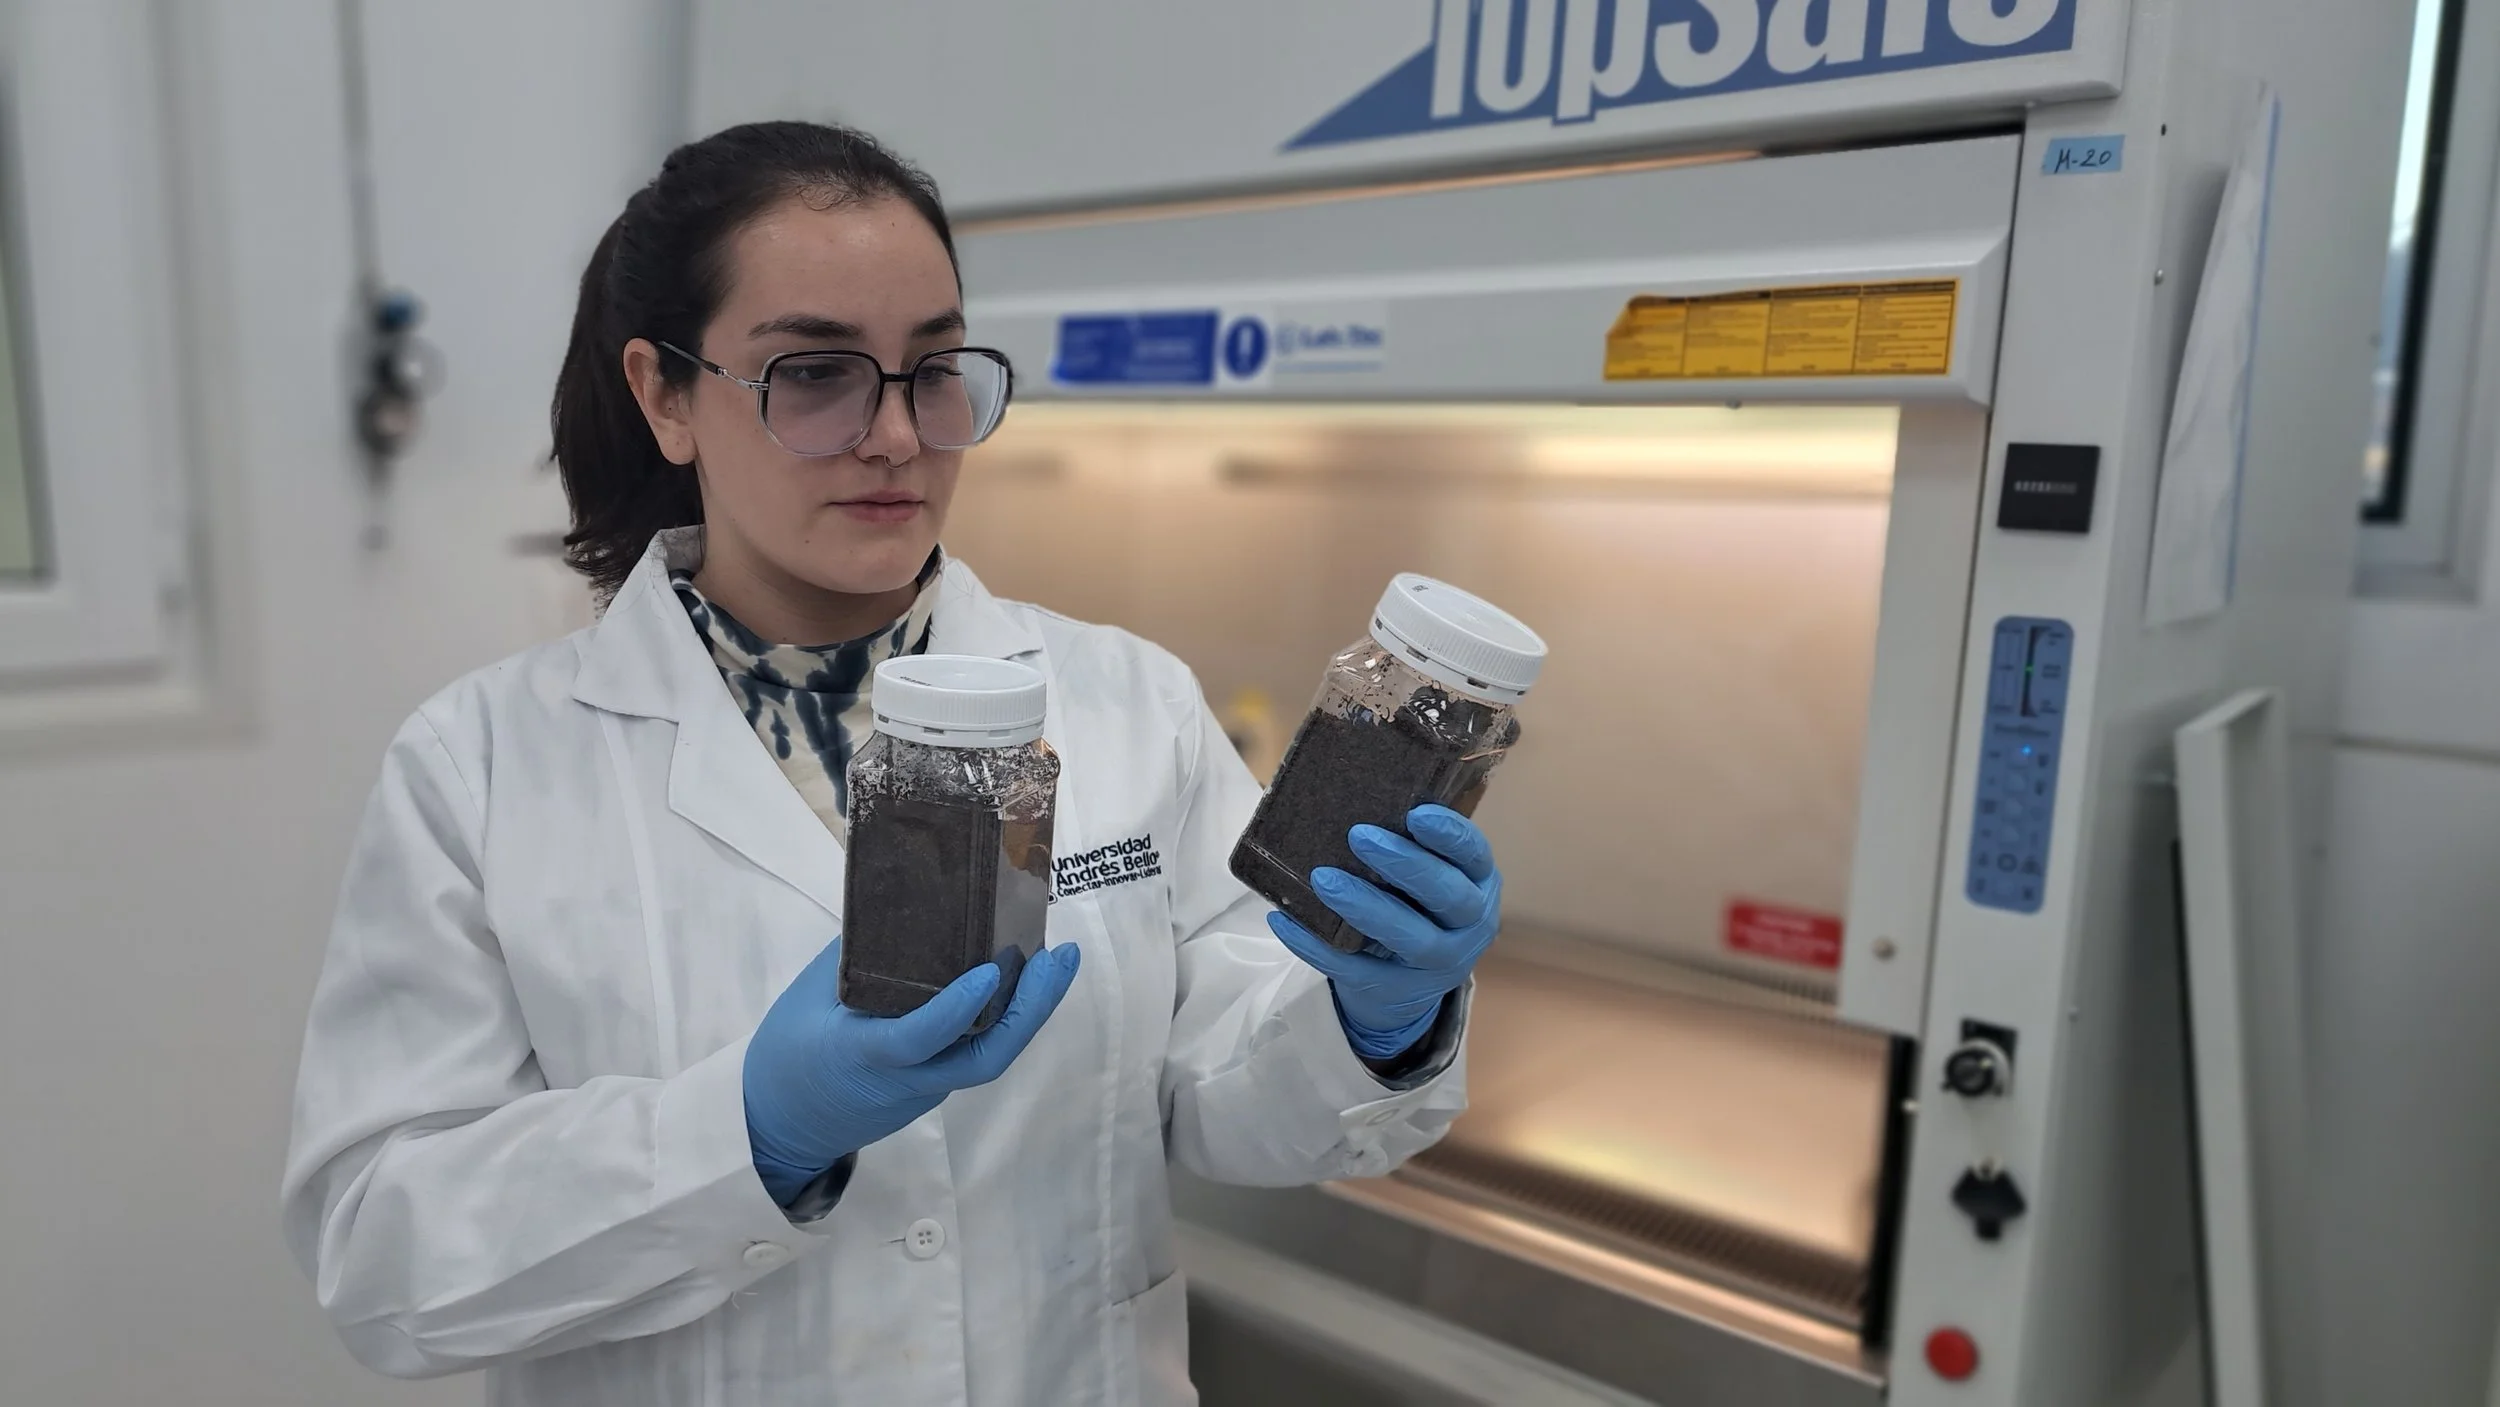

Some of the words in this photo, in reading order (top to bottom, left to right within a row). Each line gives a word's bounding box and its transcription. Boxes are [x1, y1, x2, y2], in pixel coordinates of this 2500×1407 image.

[2053, 148, 2112, 174] M-20
[1051, 833, 1152, 872] Universidad
[1056, 861, 1120, 888] Andrés
